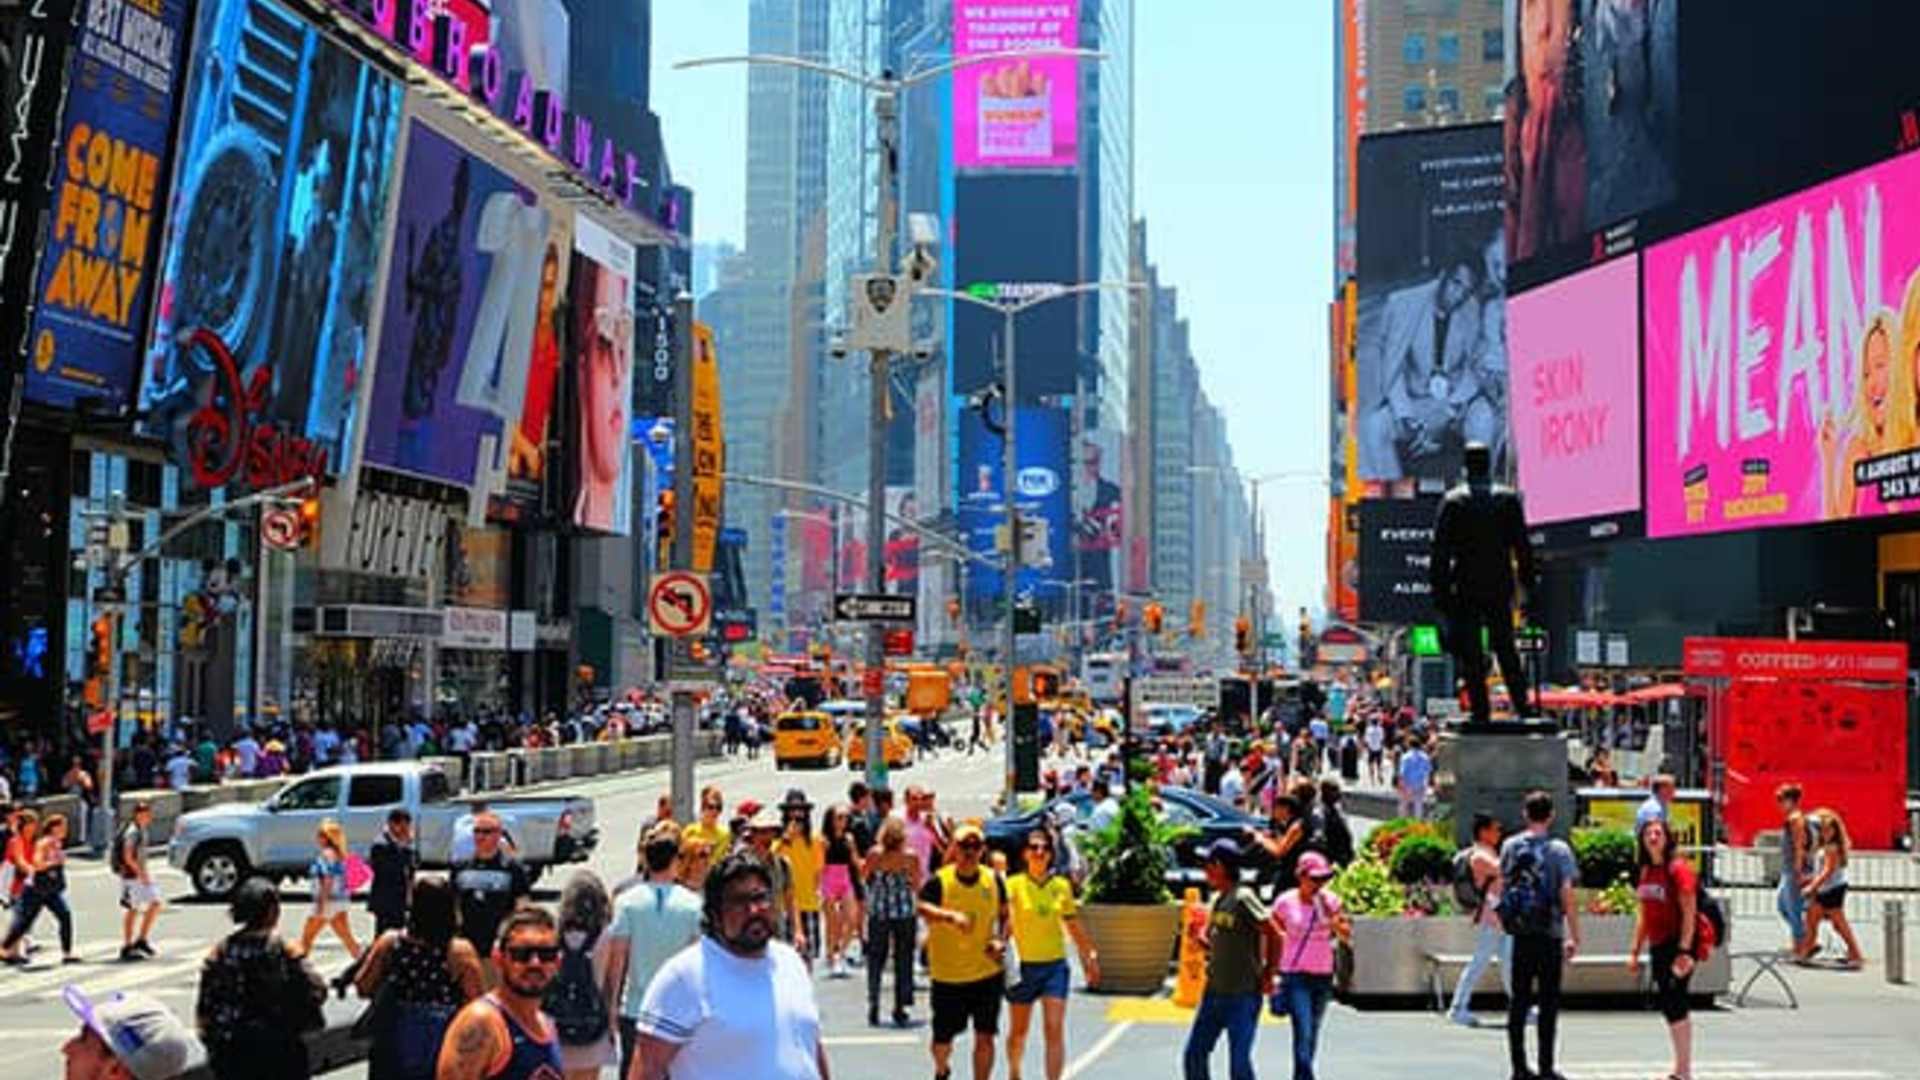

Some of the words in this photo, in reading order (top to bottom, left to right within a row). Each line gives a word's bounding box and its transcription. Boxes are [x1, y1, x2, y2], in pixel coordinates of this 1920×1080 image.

[67, 121, 161, 211] COME
[44, 248, 142, 327] AWAY
[1677, 182, 1883, 465] MEAN
[1534, 352, 1583, 408] SKIN
[1542, 401, 1611, 458] IRONY
